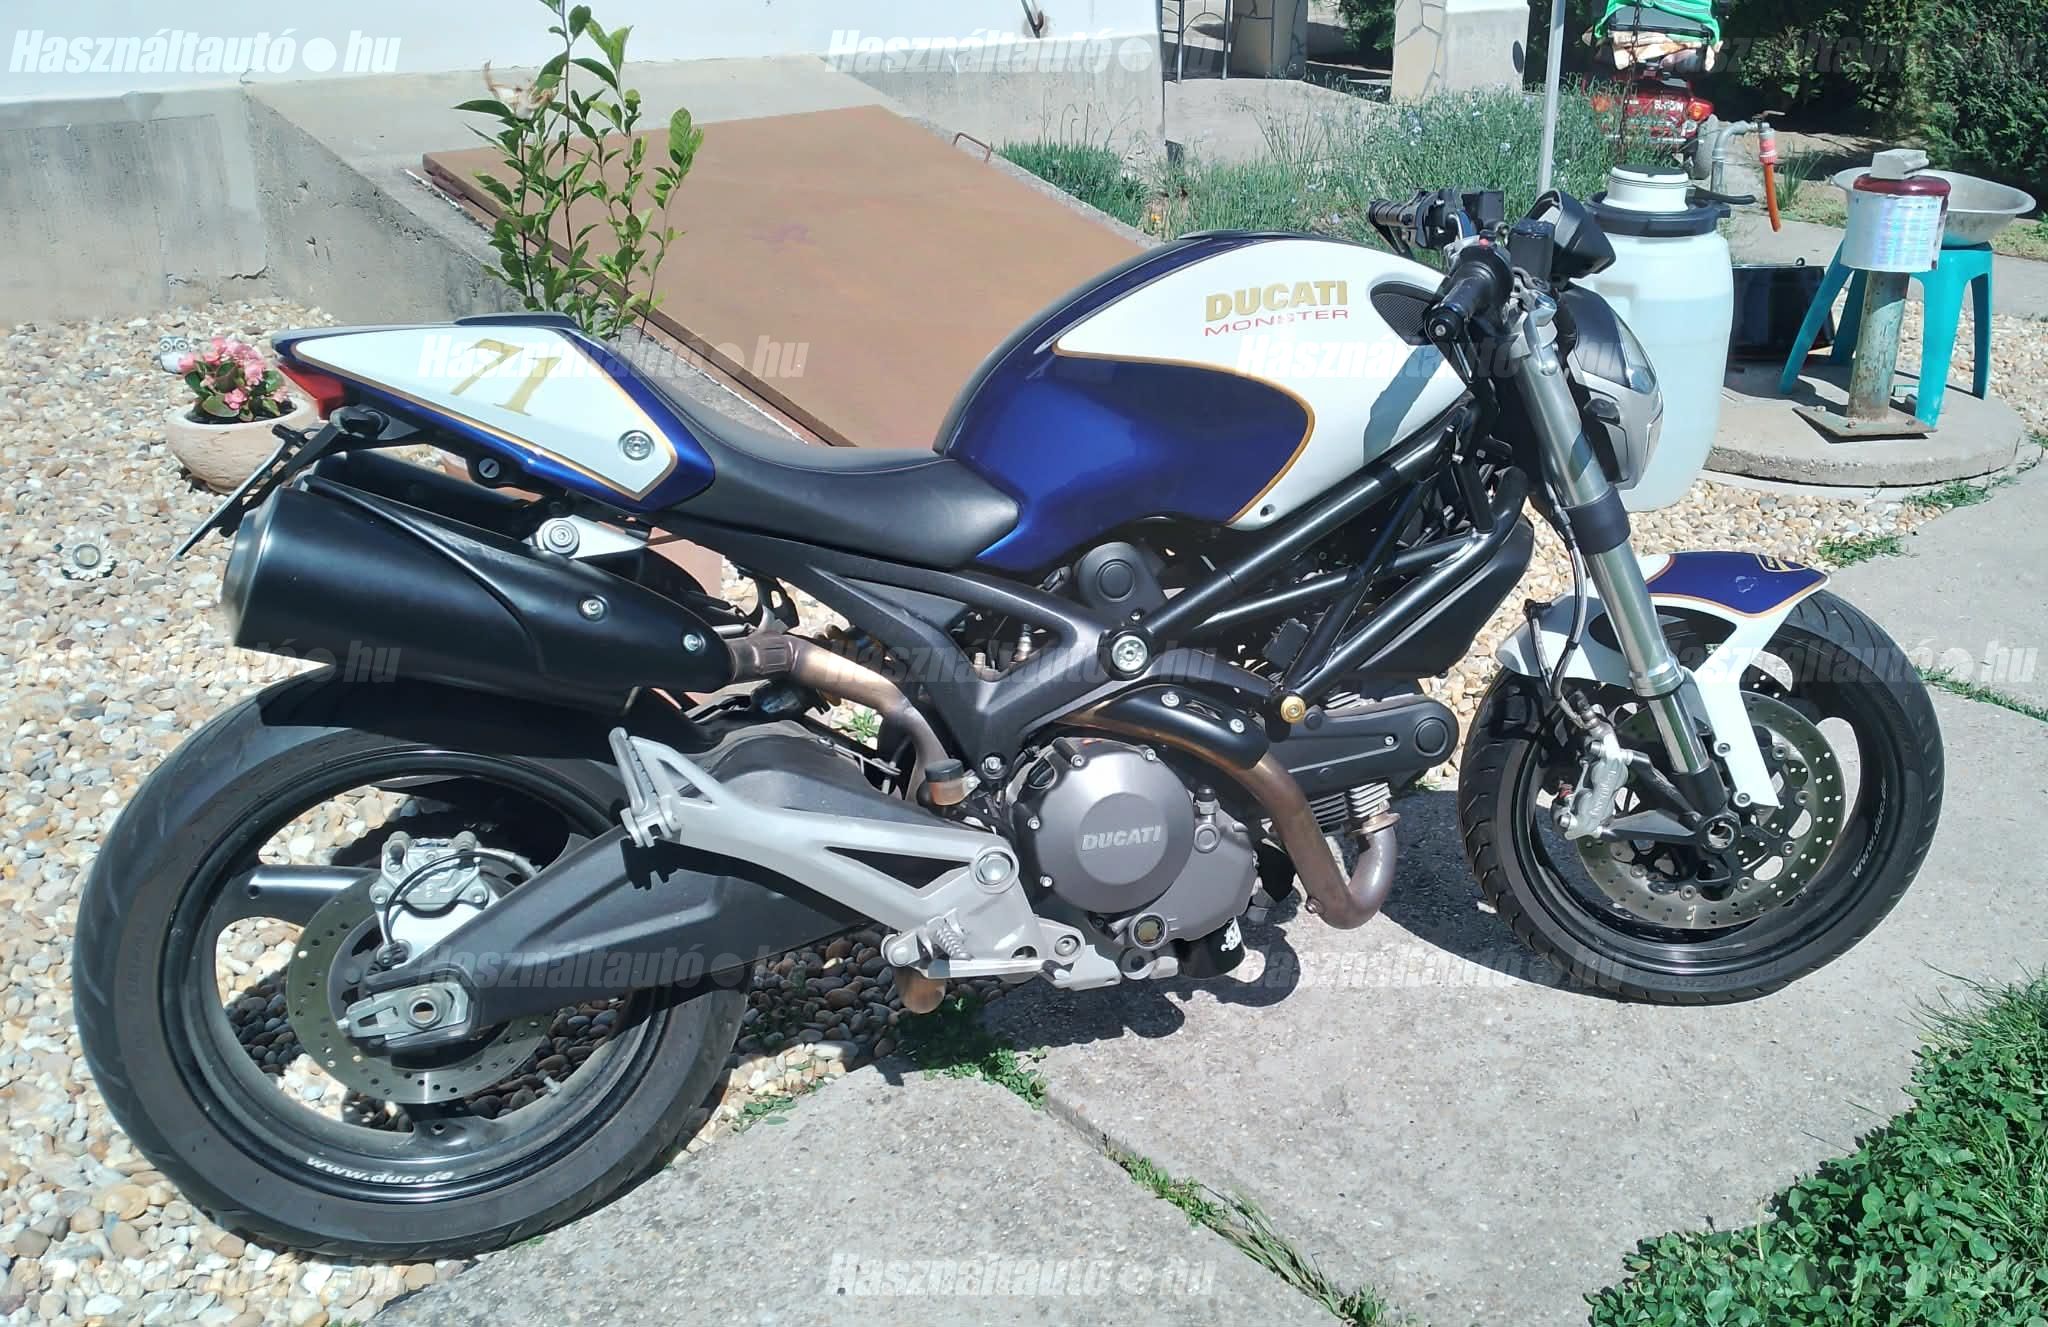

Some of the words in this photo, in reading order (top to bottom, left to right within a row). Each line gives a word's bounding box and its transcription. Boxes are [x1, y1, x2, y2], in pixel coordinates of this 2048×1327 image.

[1205, 280, 1348, 322] DUCATI
[1205, 309, 1348, 336] MONSTER
[450, 338, 562, 416] 71
[1081, 824, 1161, 851] DUCATI
[307, 1156, 455, 1184] www.duc.de
